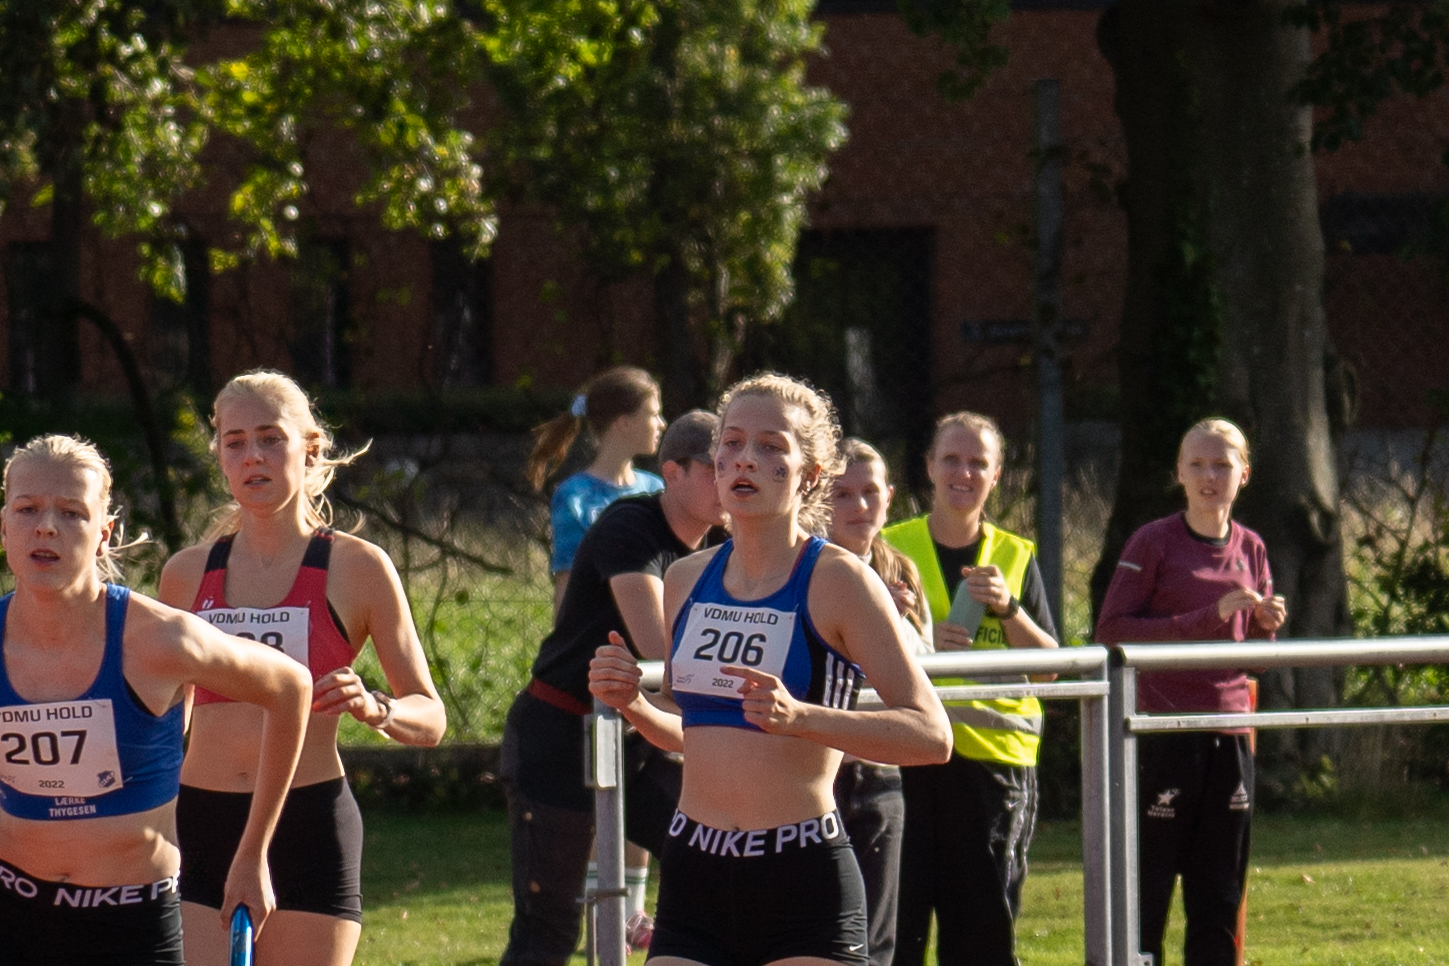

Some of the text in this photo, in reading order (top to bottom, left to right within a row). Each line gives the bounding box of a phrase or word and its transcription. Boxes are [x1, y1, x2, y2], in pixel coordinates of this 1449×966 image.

[208, 611, 290, 624] VDMU HOLD
[704, 607, 779, 625] VDMU HOLD
[693, 628, 767, 666] 206
[712, 678, 734, 688] 2022
[46, 705, 93, 720] HOLD
[0, 730, 87, 766] 207
[38, 780, 65, 788] 2022
[48, 804, 97, 818] THYGESEN
[688, 823, 768, 858] NIKE
[775, 811, 840, 854] PRO
[53, 885, 144, 908] NIKE
